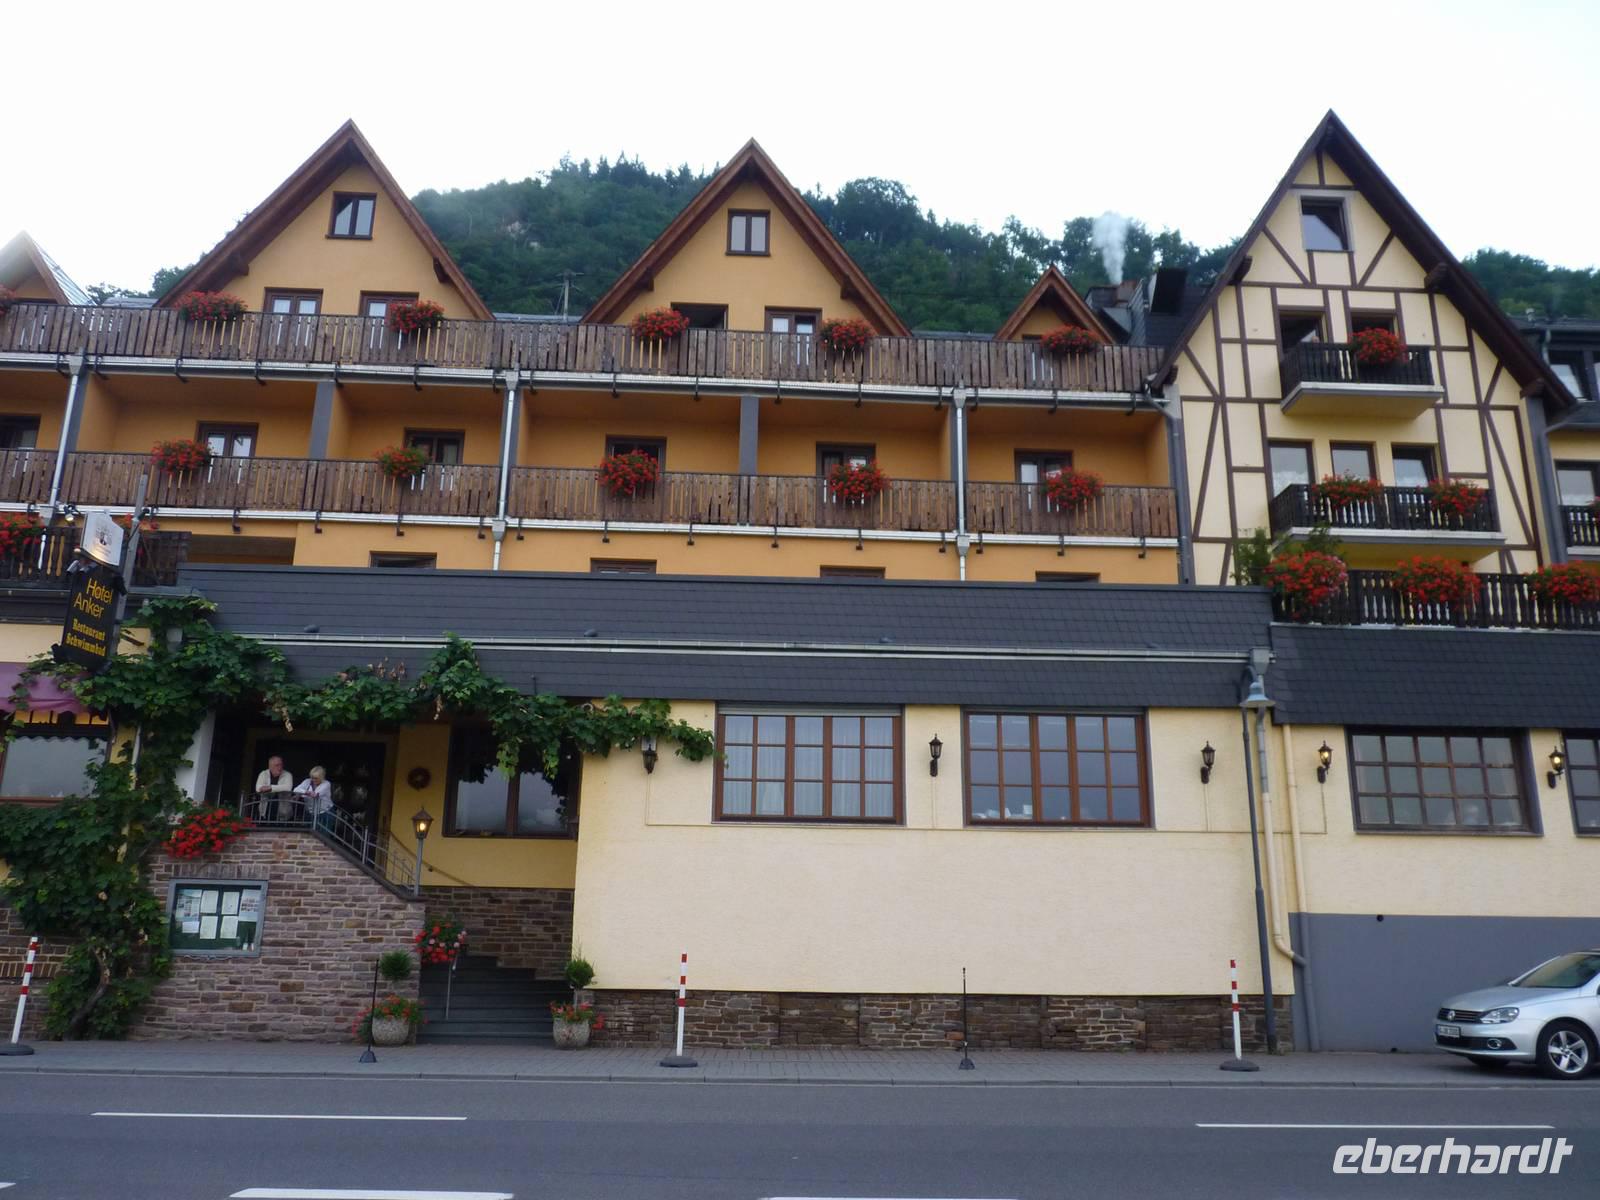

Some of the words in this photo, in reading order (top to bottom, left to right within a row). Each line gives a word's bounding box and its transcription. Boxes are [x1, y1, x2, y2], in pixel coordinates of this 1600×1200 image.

[86, 578, 113, 604] Hotel
[74, 592, 104, 617] Anker
[72, 618, 105, 641] Restaurant
